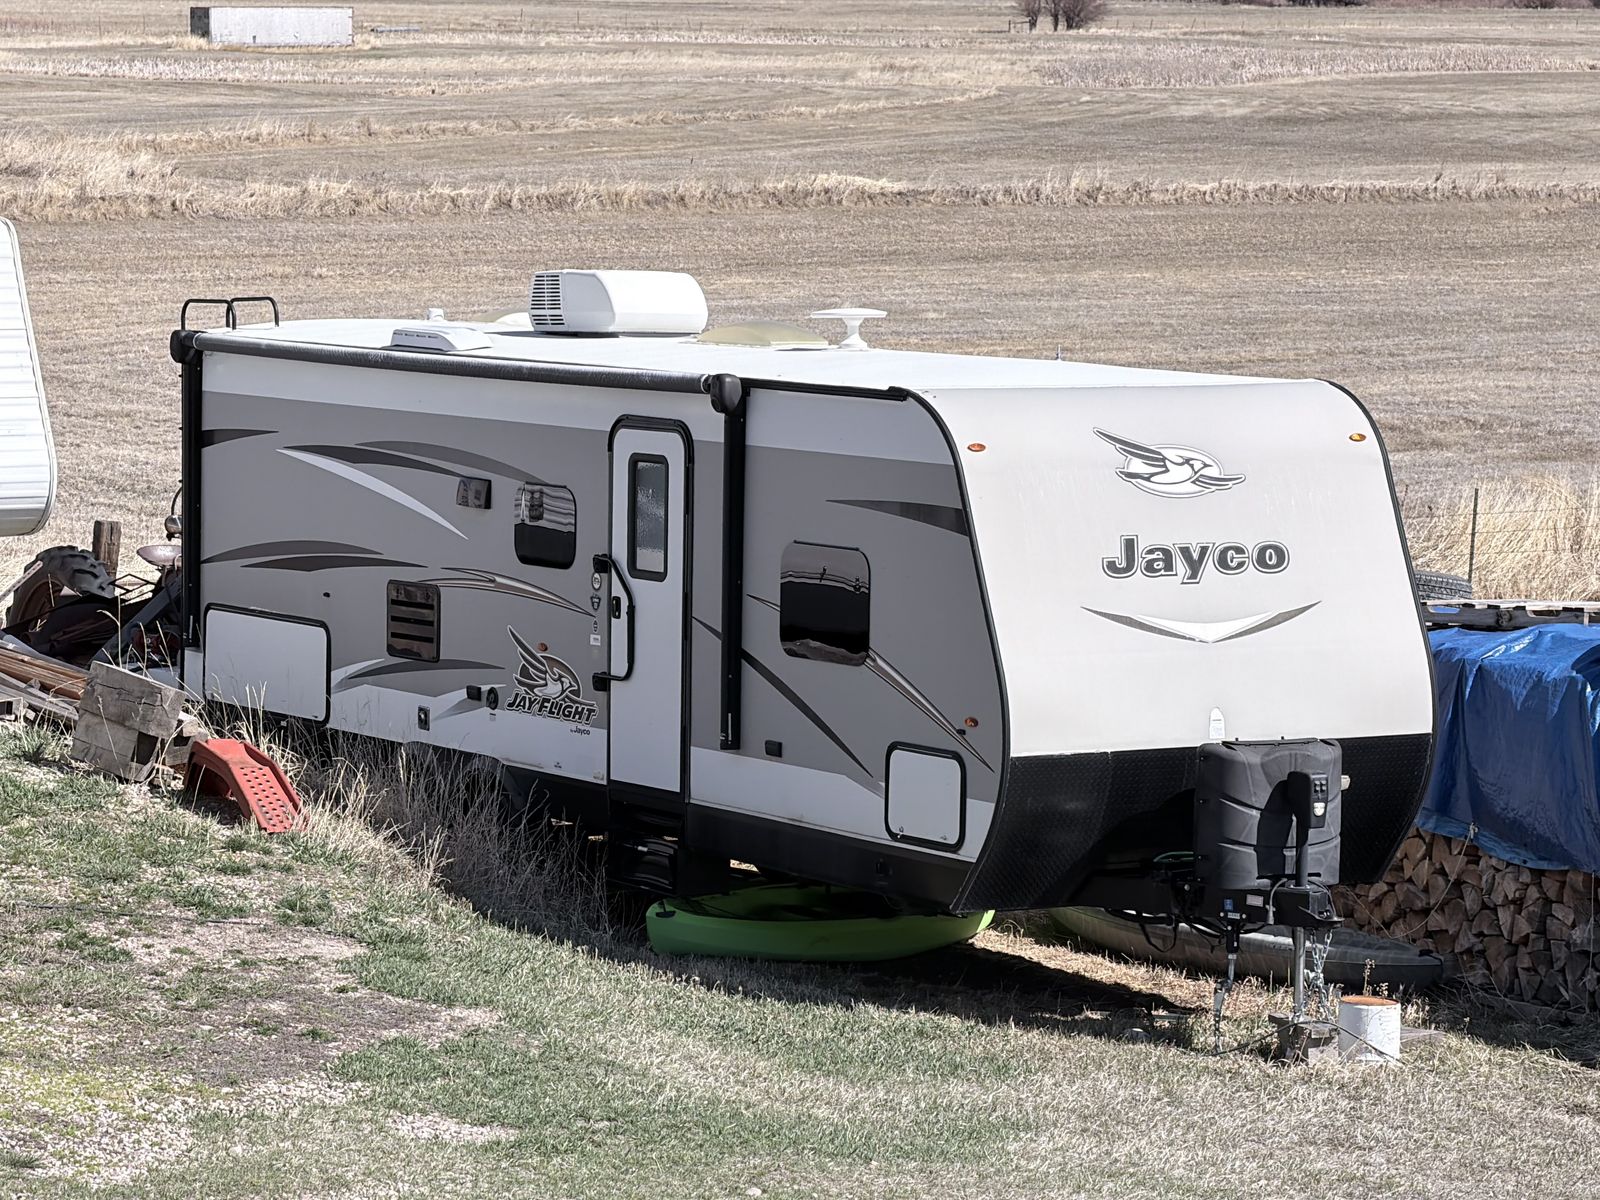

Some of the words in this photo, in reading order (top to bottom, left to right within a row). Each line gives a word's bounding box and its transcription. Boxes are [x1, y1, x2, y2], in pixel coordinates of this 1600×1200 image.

[1102, 534, 1290, 584] Jayco
[506, 690, 538, 714] JAY
[537, 695, 598, 725] FLIGHT
[573, 726, 591, 736] Jayco
